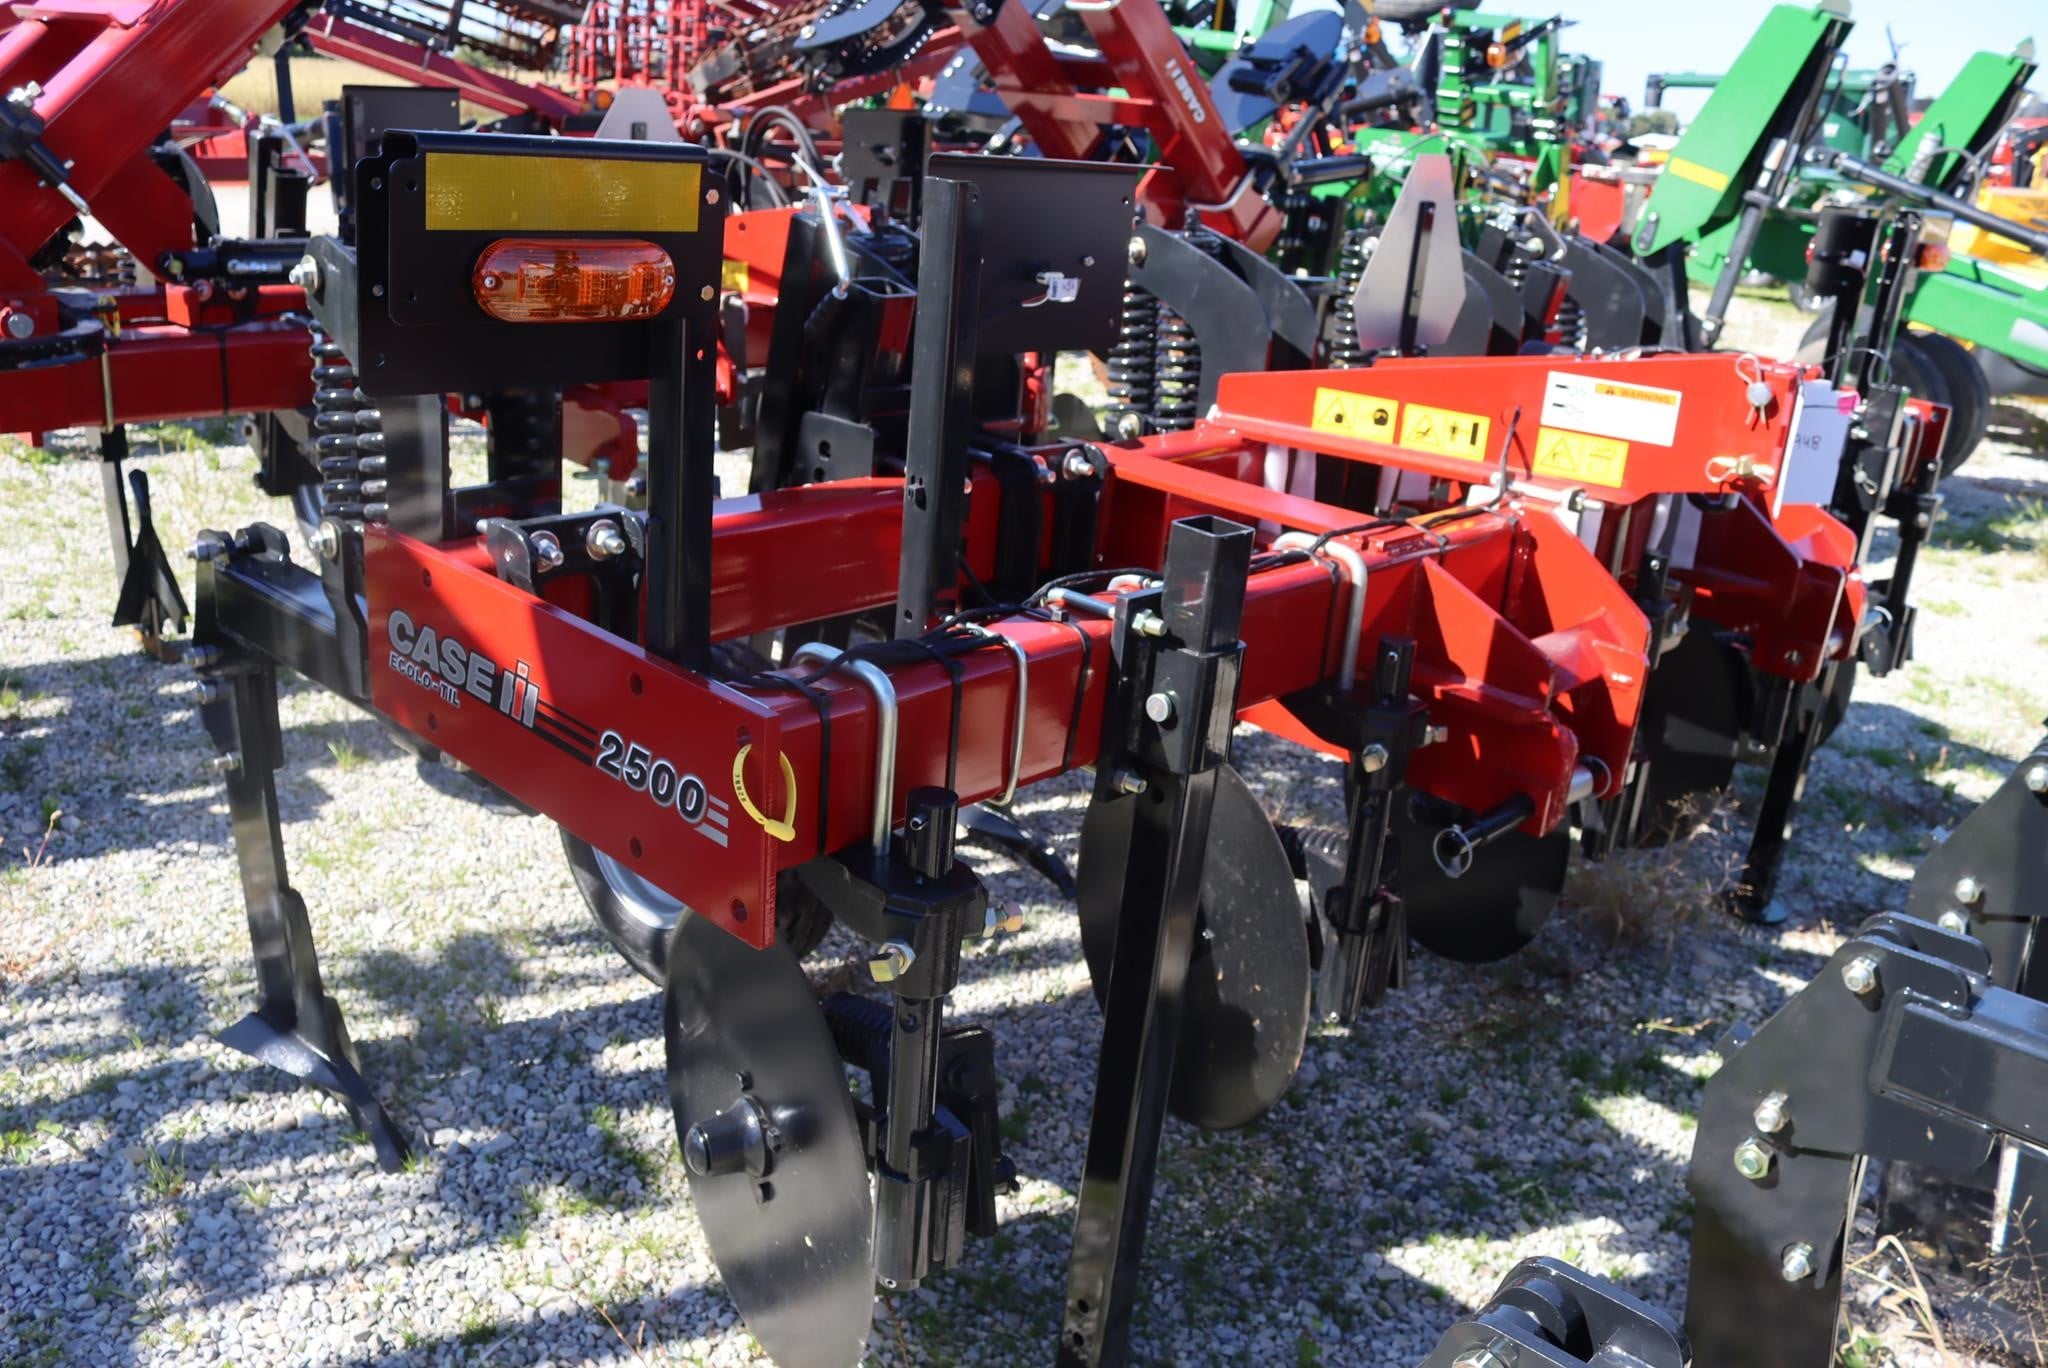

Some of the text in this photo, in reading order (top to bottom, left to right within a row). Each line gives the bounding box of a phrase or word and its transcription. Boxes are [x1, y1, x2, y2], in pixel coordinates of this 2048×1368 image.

[1174, 74, 1206, 124] CASE
[1619, 388, 1672, 405] WARNING
[387, 609, 497, 704] CASE
[389, 651, 461, 711] ECOLO-TIL
[595, 730, 708, 824] 2500
